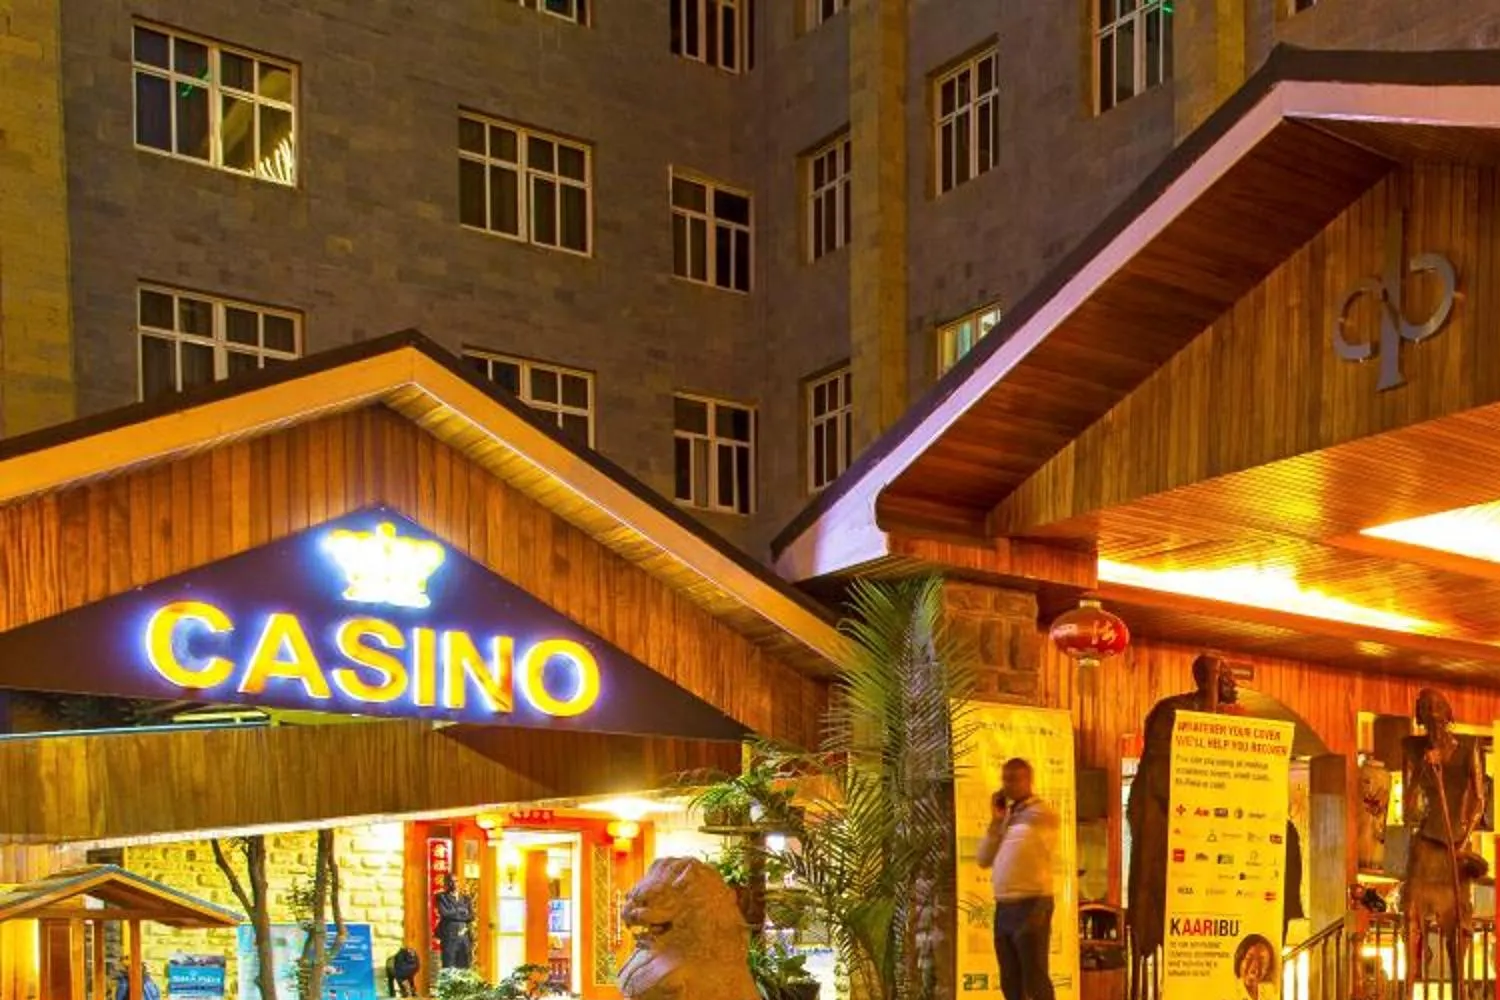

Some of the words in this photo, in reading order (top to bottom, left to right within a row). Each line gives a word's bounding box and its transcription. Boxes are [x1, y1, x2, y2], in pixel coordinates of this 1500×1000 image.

[145, 601, 600, 717] CASINO
[1207, 738, 1228, 750] HELP
[1231, 740, 1249, 752] YOU
[1170, 917, 1239, 936] KAARIBU
